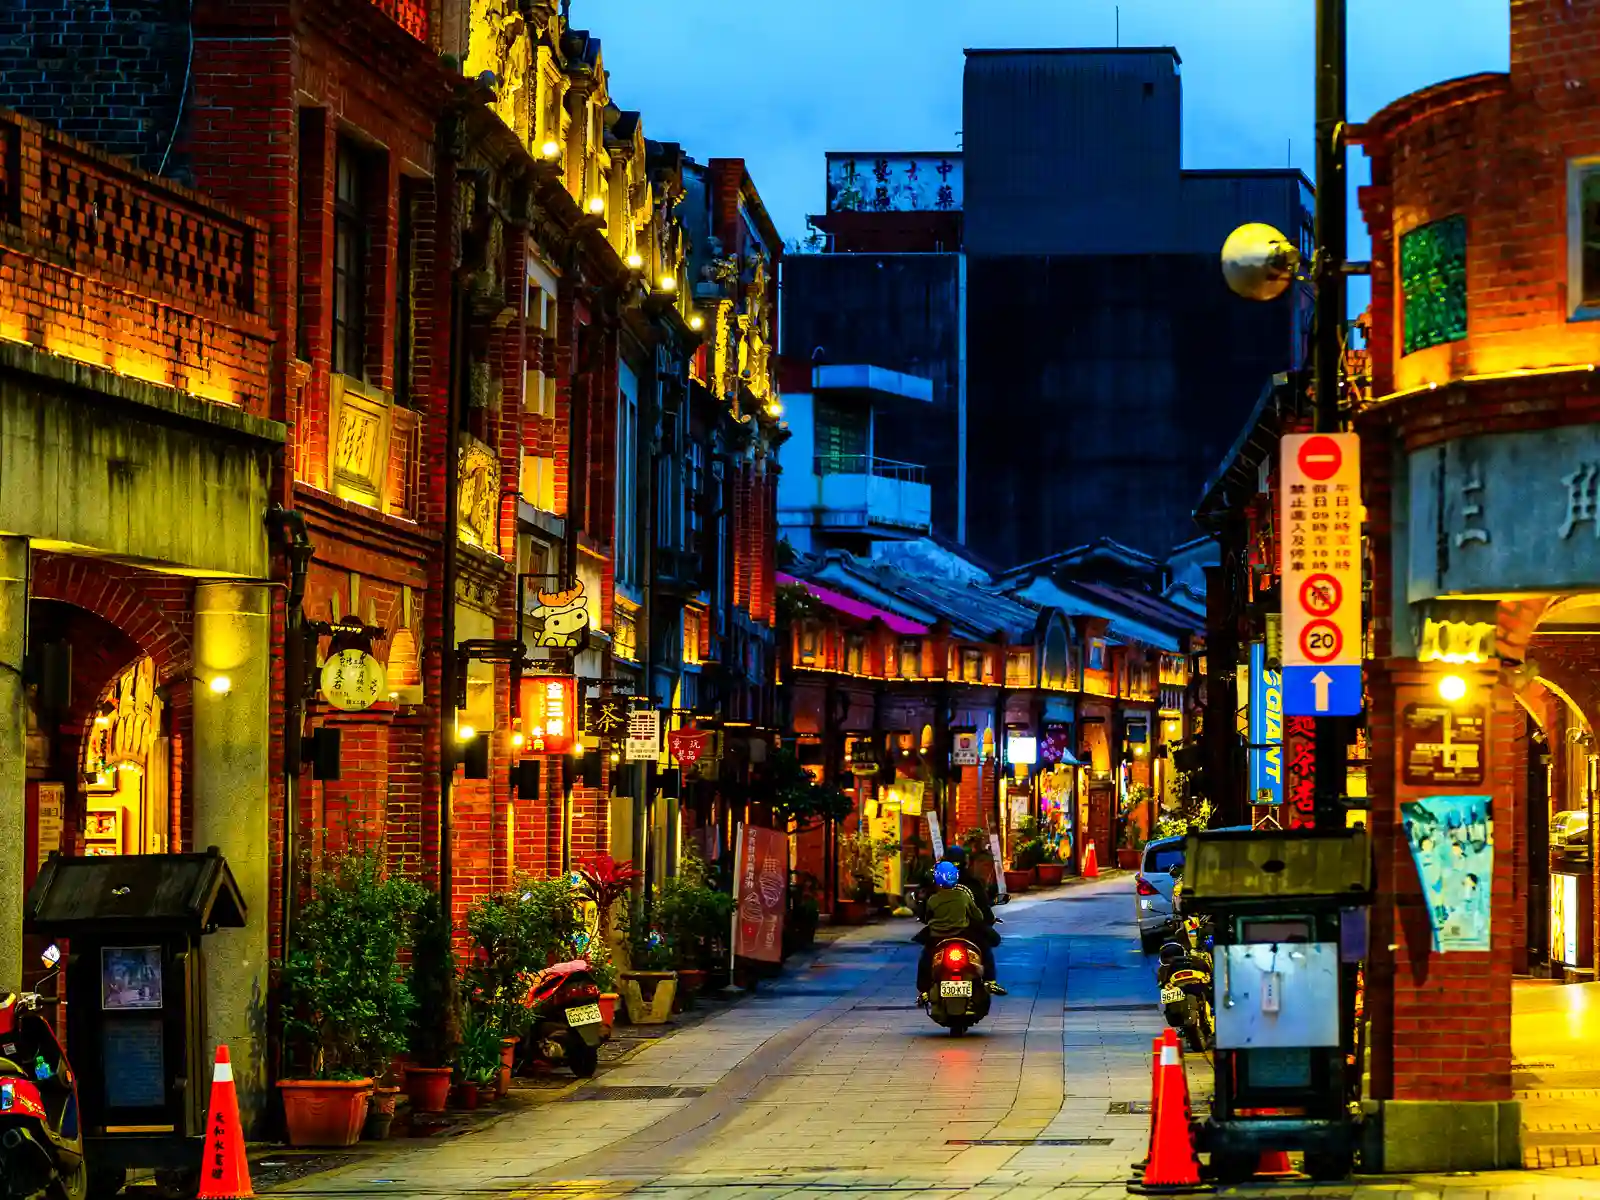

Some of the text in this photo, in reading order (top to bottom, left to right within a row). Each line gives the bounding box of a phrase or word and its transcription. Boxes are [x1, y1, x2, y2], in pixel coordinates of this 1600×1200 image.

[1309, 633, 1334, 649] 20
[597, 703, 624, 732] 茶
[1265, 686, 1283, 784] GIANT
